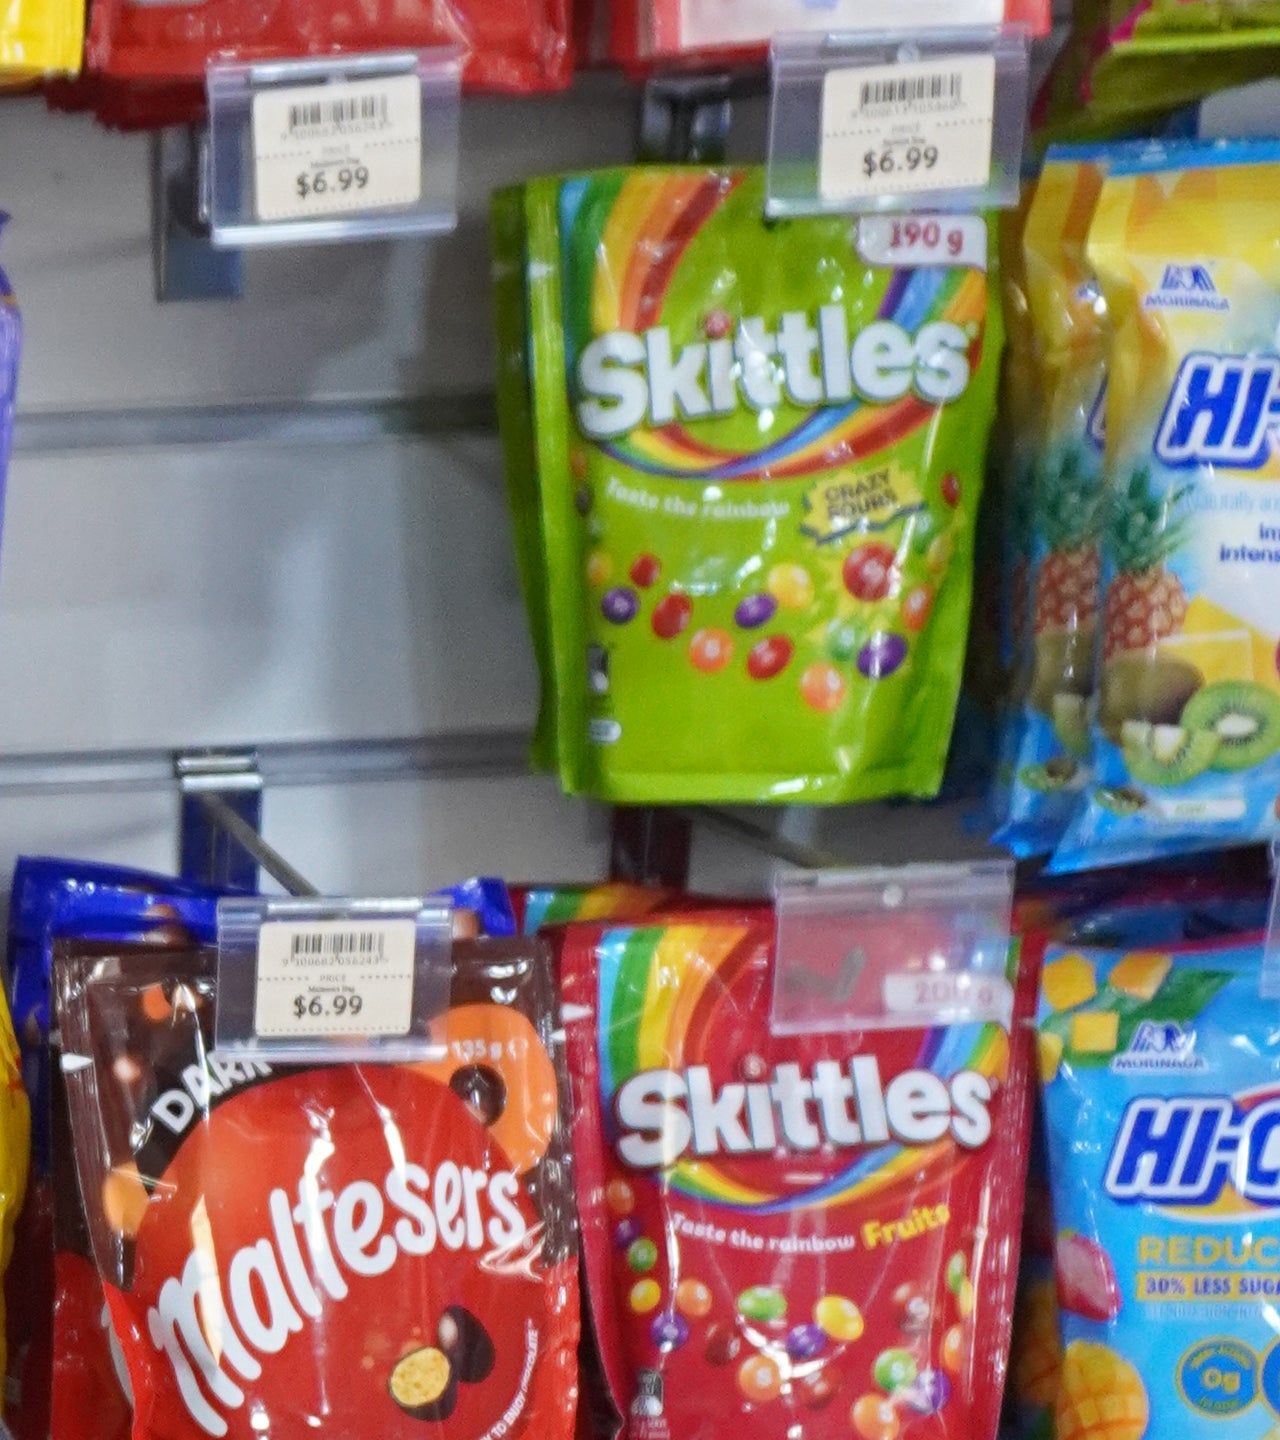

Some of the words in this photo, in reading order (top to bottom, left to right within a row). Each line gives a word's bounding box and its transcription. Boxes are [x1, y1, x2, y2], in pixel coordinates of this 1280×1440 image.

[862, 145, 939, 178] $6.99
[295, 165, 370, 201] $6.99
[891, 220, 940, 249] 190
[946, 229, 964, 256] g
[576, 304, 971, 440] Skittles
[825, 470, 890, 501] CRAZY
[319, 974, 347, 984] PRICE
[293, 994, 364, 1020] $6.99
[451, 1040, 487, 1058] 135
[153, 1042, 274, 1137] DARK
[614, 1053, 992, 1169] Skittles
[669, 1212, 726, 1245] Taste
[729, 1226, 766, 1251] the
[767, 1233, 856, 1256] rainbow
[861, 1203, 952, 1250] Fruits
[148, 1160, 530, 1440] Maltesers
[1146, 1276, 1185, 1296] 30%
[1193, 1275, 1233, 1296] LESS
[1200, 1367, 1242, 1392] 0g
[490, 1420, 508, 1439] TO
[502, 1390, 527, 1427] ENJOY
